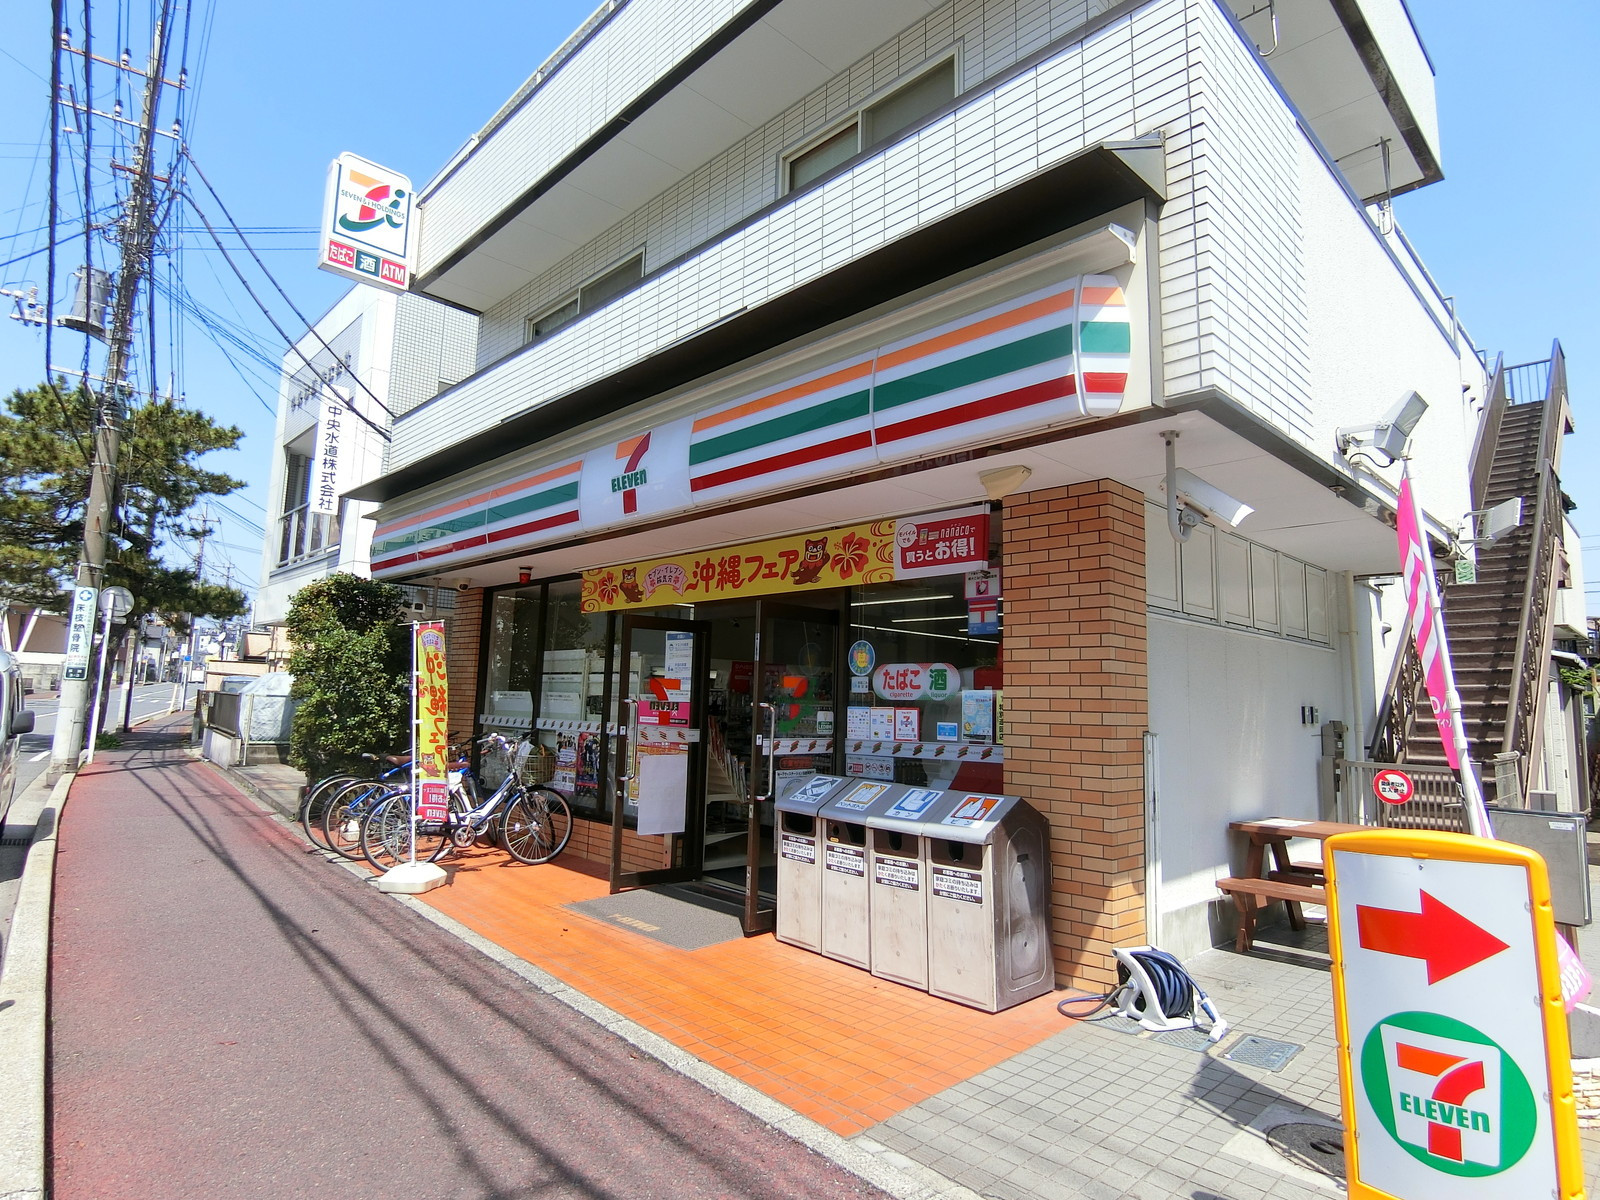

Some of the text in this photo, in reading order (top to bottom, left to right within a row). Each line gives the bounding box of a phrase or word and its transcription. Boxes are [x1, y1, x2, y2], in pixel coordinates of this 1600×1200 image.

[371, 201, 405, 220] HOLDINGS
[330, 243, 405, 283] たばこ 酒 ATM
[318, 405, 342, 511] 中央水道株式会社
[898, 530, 916, 538] モバイル
[685, 549, 799, 593] 沖縄フェア
[882, 668, 948, 691] たばこ 酒
[930, 691, 947, 699] liquor
